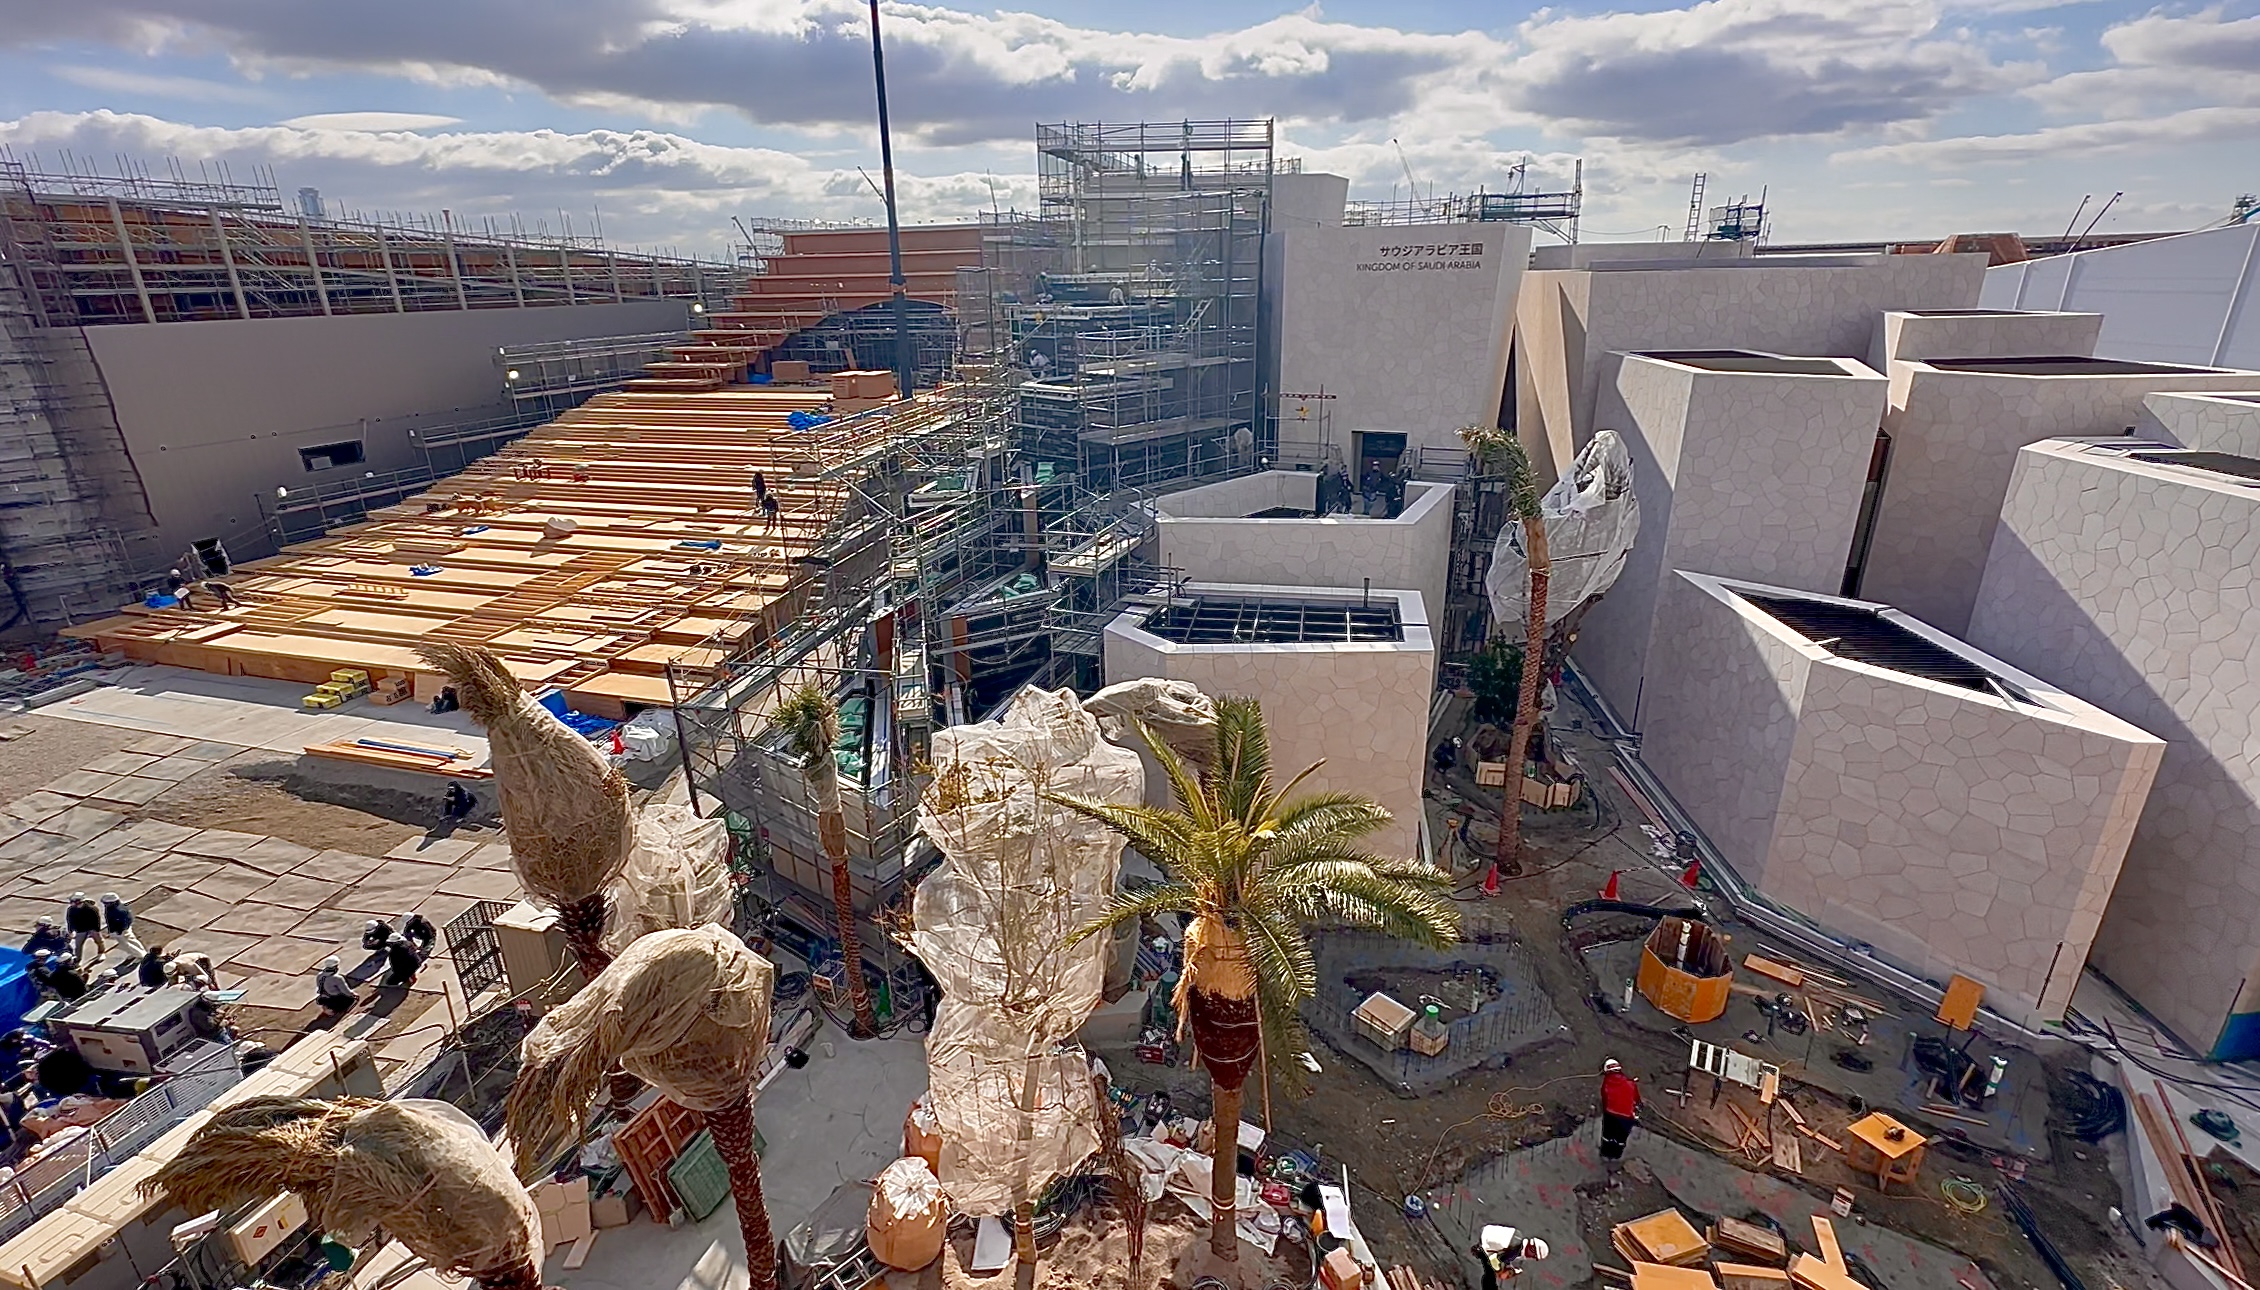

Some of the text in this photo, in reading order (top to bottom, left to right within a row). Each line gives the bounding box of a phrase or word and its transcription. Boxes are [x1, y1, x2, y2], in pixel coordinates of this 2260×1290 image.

[1380, 243, 1483, 257] サウジアラビア王国
[1356, 260, 1481, 271] KINGDOM OF SAUDI ARABIA
